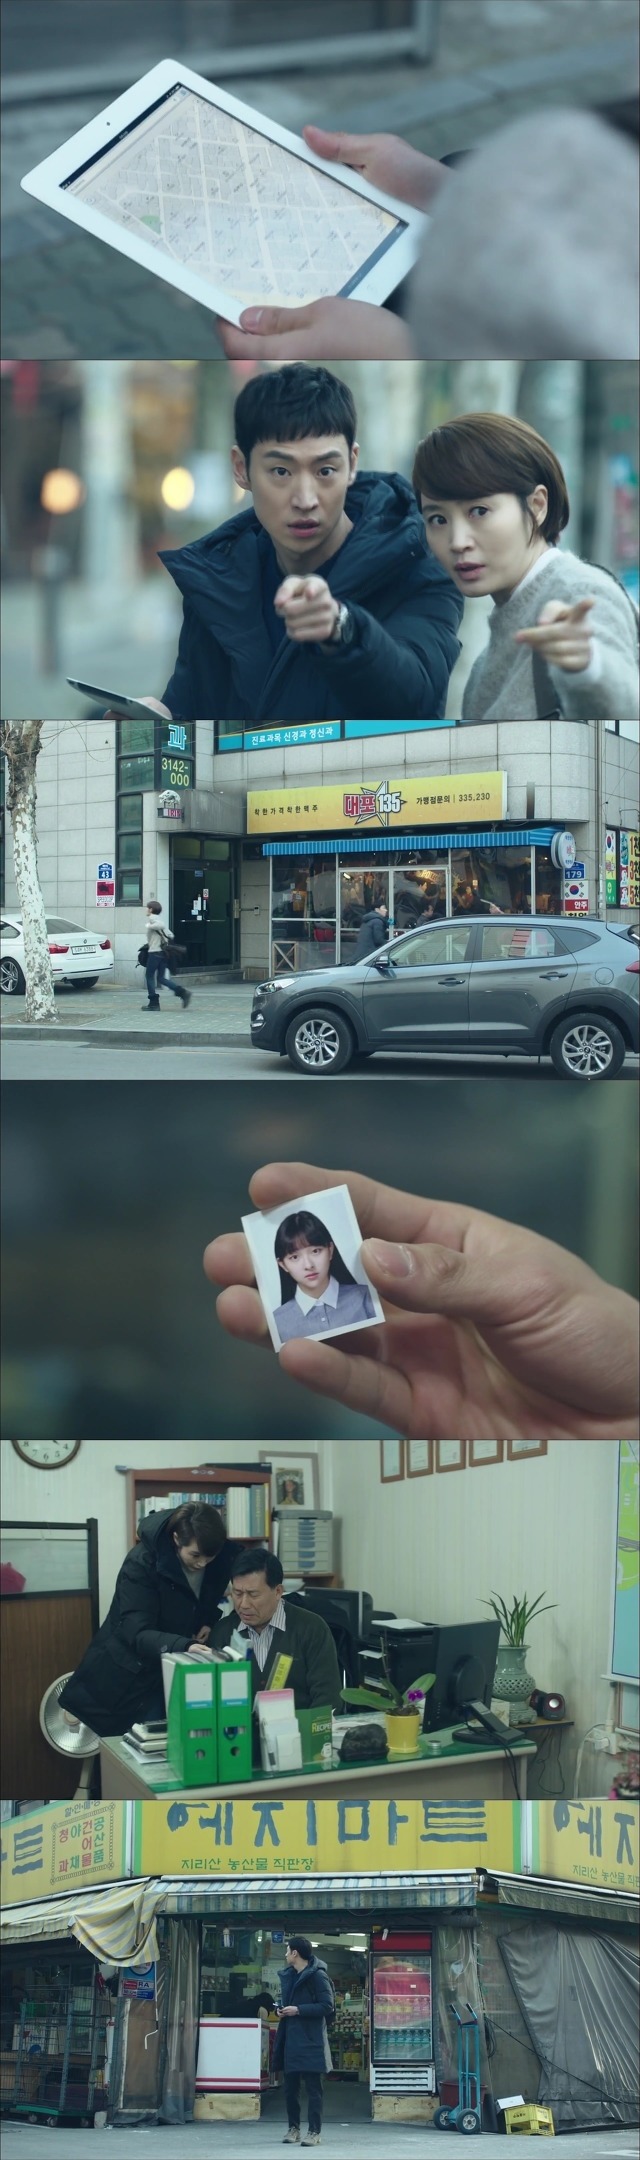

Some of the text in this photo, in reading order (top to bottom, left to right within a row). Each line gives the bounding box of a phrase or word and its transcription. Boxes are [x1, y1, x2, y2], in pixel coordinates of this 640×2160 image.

[168, 724, 187, 750] 과
[251, 727, 333, 746] 진료과목 신경과 정신과
[170, 772, 190, 787] 000
[416, 795, 450, 805] 가맹점문의
[101, 871, 109, 879] 43
[566, 870, 582, 879] 179
[574, 901, 588, 910] 안주
[181, 1858, 314, 1872] 지리산 농산물 직판장
[573, 1864, 597, 1880] 지리산
[602, 1869, 625, 1885] 농산물
